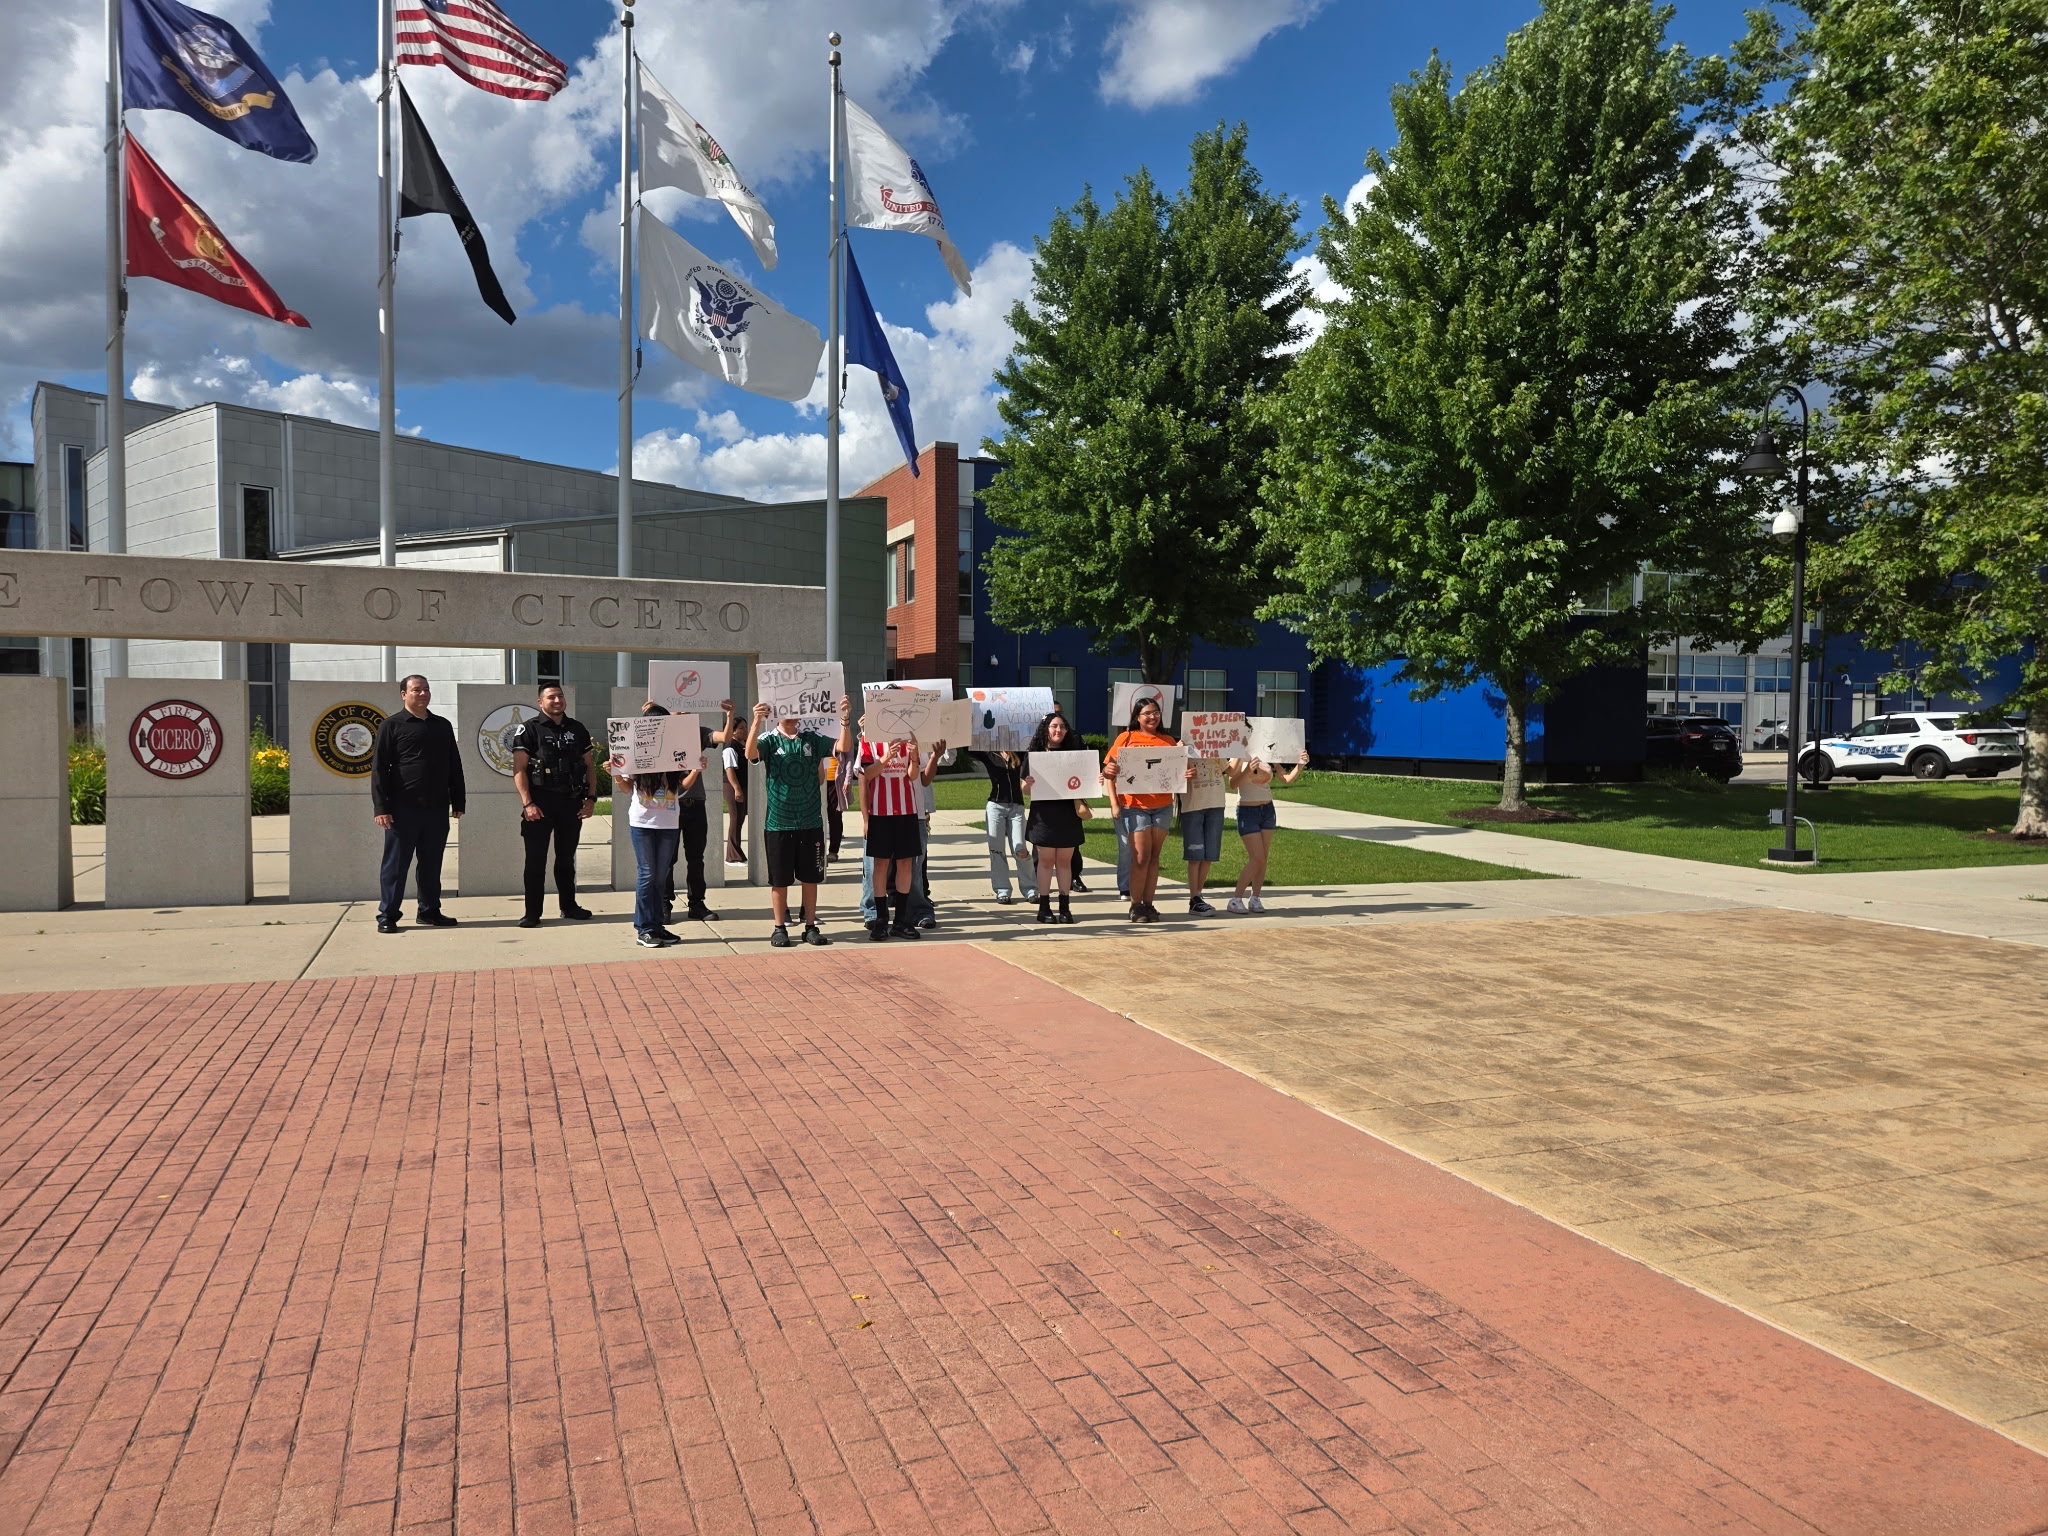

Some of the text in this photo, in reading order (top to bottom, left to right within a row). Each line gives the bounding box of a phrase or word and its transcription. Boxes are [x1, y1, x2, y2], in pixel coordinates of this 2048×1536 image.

[885, 201, 923, 212] UNITED
[187, 260, 224, 280] STATES
[685, 265, 702, 281] UNITED
[733, 281, 753, 298] COAST
[84, 575, 307, 618] TOWN
[363, 587, 447, 622] OF
[511, 593, 751, 633] CICERO
[761, 664, 802, 685] STOP
[798, 690, 831, 704] GUN
[159, 706, 193, 718] FIRE
[765, 701, 837, 719] IOLENCE
[608, 721, 631, 733] STOP
[1192, 714, 1208, 727] WE
[317, 714, 337, 751] TOWN
[338, 706, 356, 717] OF
[1206, 729, 1227, 739] LIVE
[150, 728, 202, 750] CICERO
[1194, 740, 1232, 750] WITHOUT
[1200, 750, 1219, 758] FEAR
[1846, 743, 1909, 757] POLICE
[158, 761, 200, 773] DEPT.
